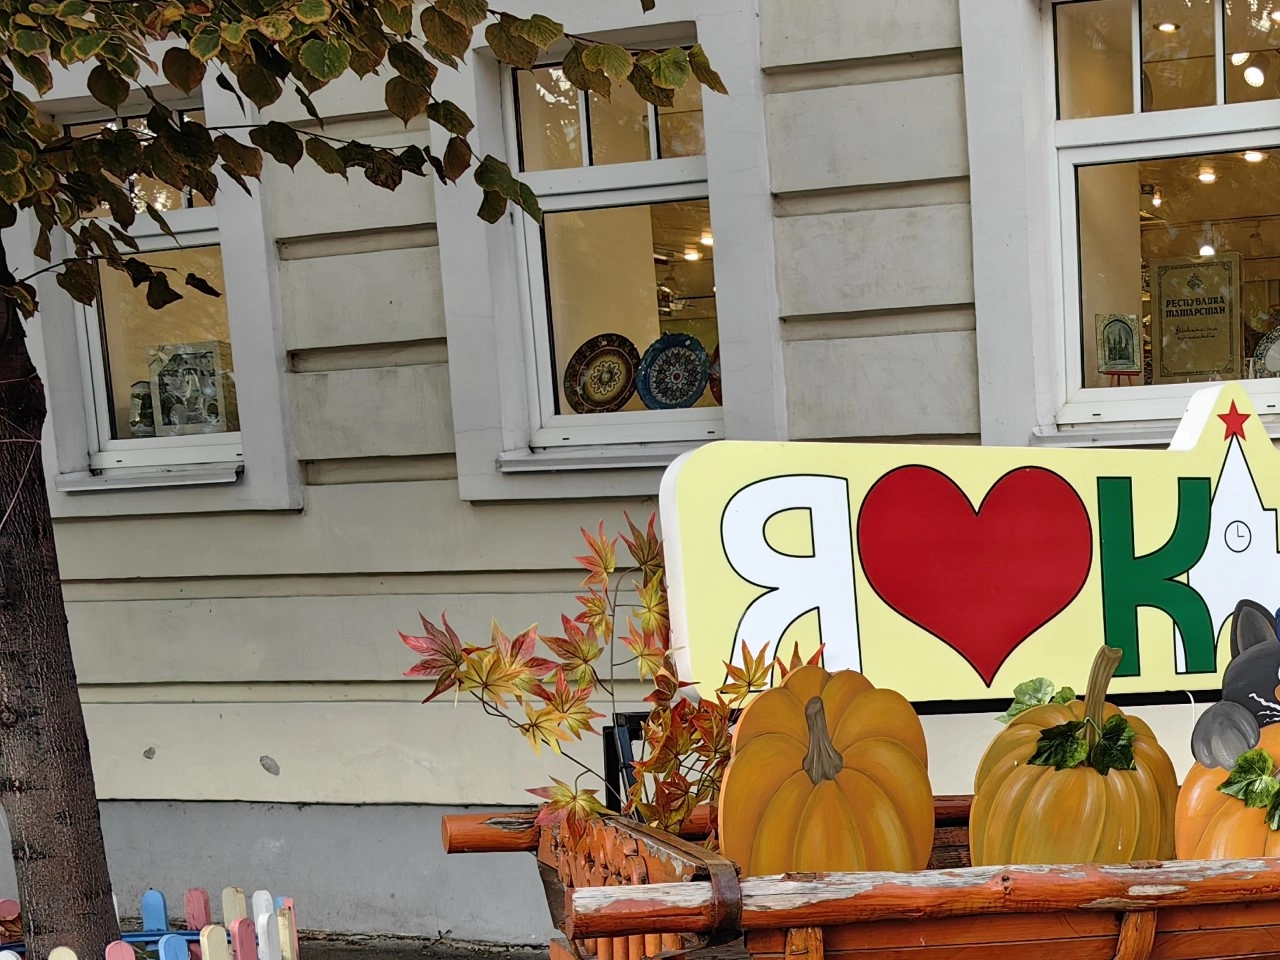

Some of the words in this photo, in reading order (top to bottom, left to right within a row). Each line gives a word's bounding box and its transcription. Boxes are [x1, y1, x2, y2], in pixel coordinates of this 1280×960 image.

[1165, 295, 1225, 308] РЕСПУБЛИКА
[1165, 306, 1226, 318] ТАТАРСТАН
[719, 472, 864, 695] Я
